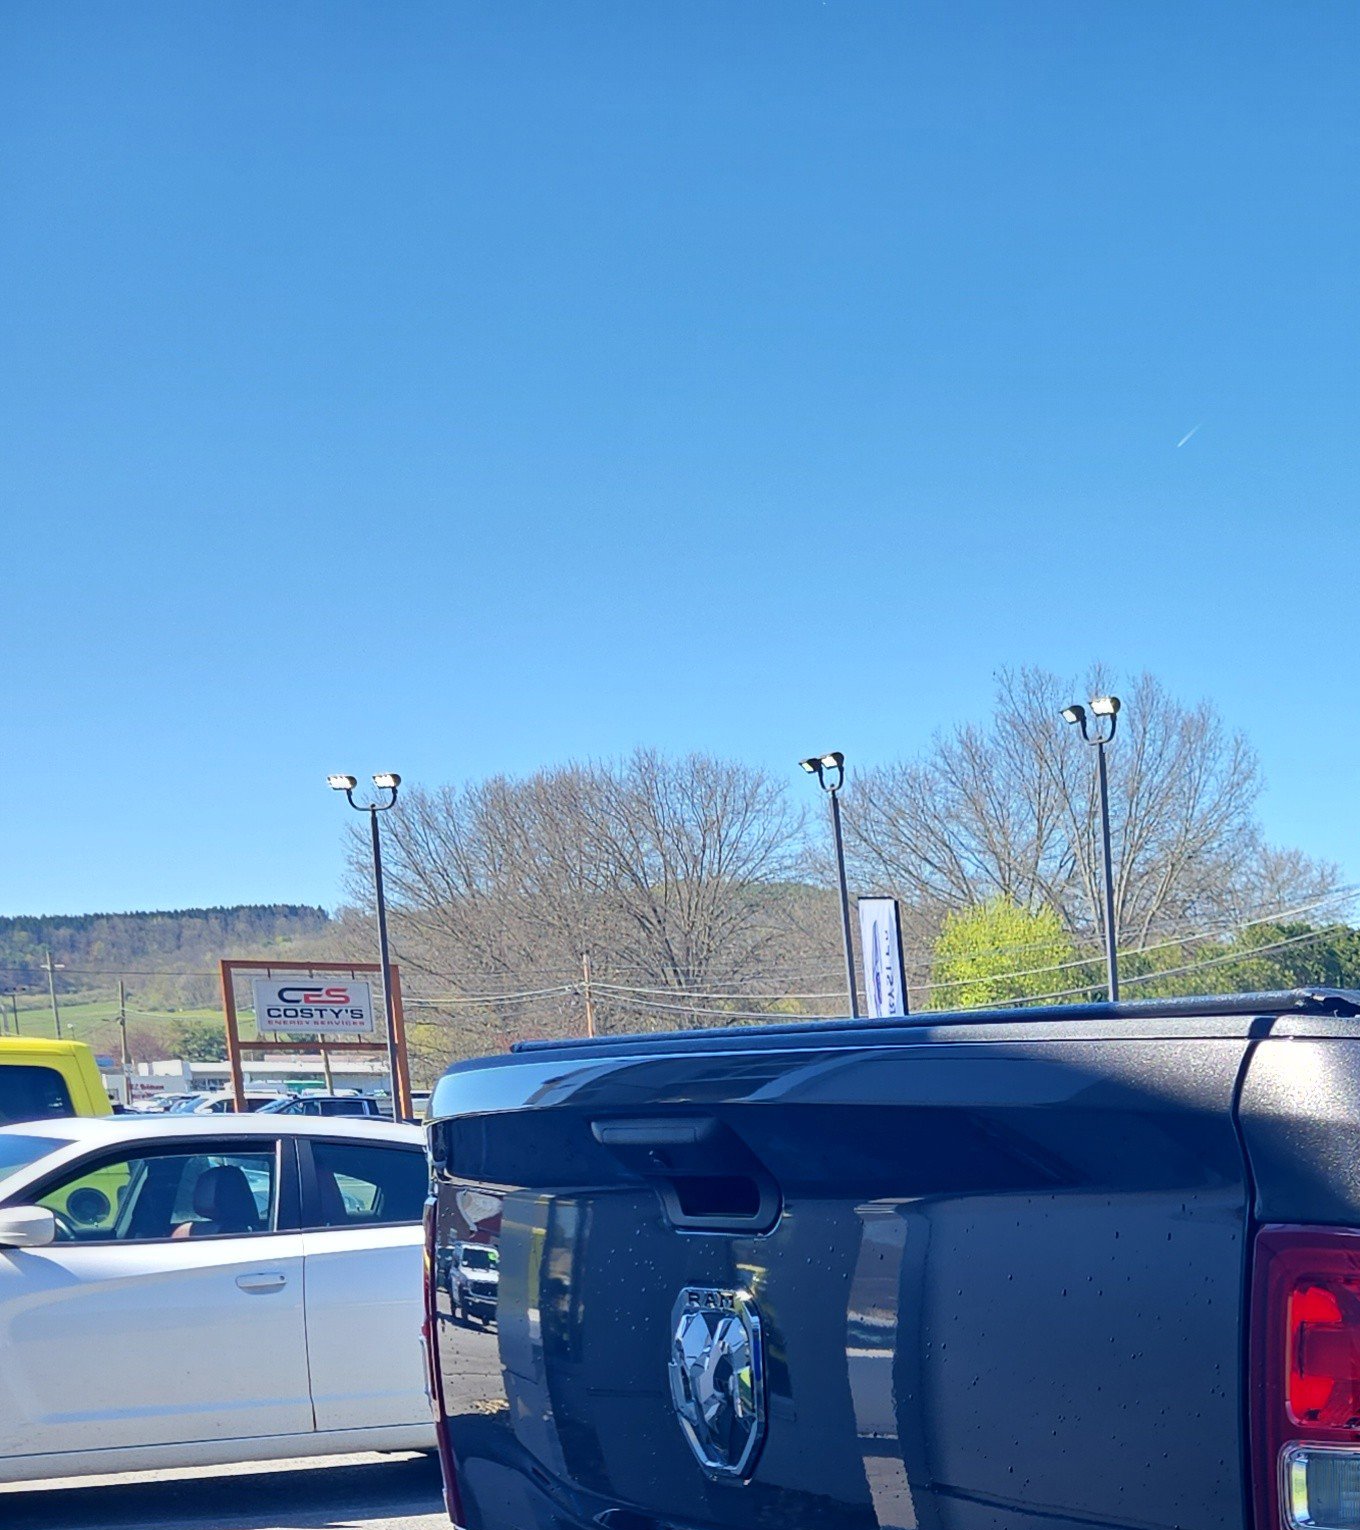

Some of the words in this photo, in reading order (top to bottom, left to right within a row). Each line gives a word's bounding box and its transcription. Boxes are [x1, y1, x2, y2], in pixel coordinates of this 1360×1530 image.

[277, 987, 351, 1005] CES
[266, 1007, 364, 1020] COSTY'S
[688, 1291, 734, 1309] RAM
